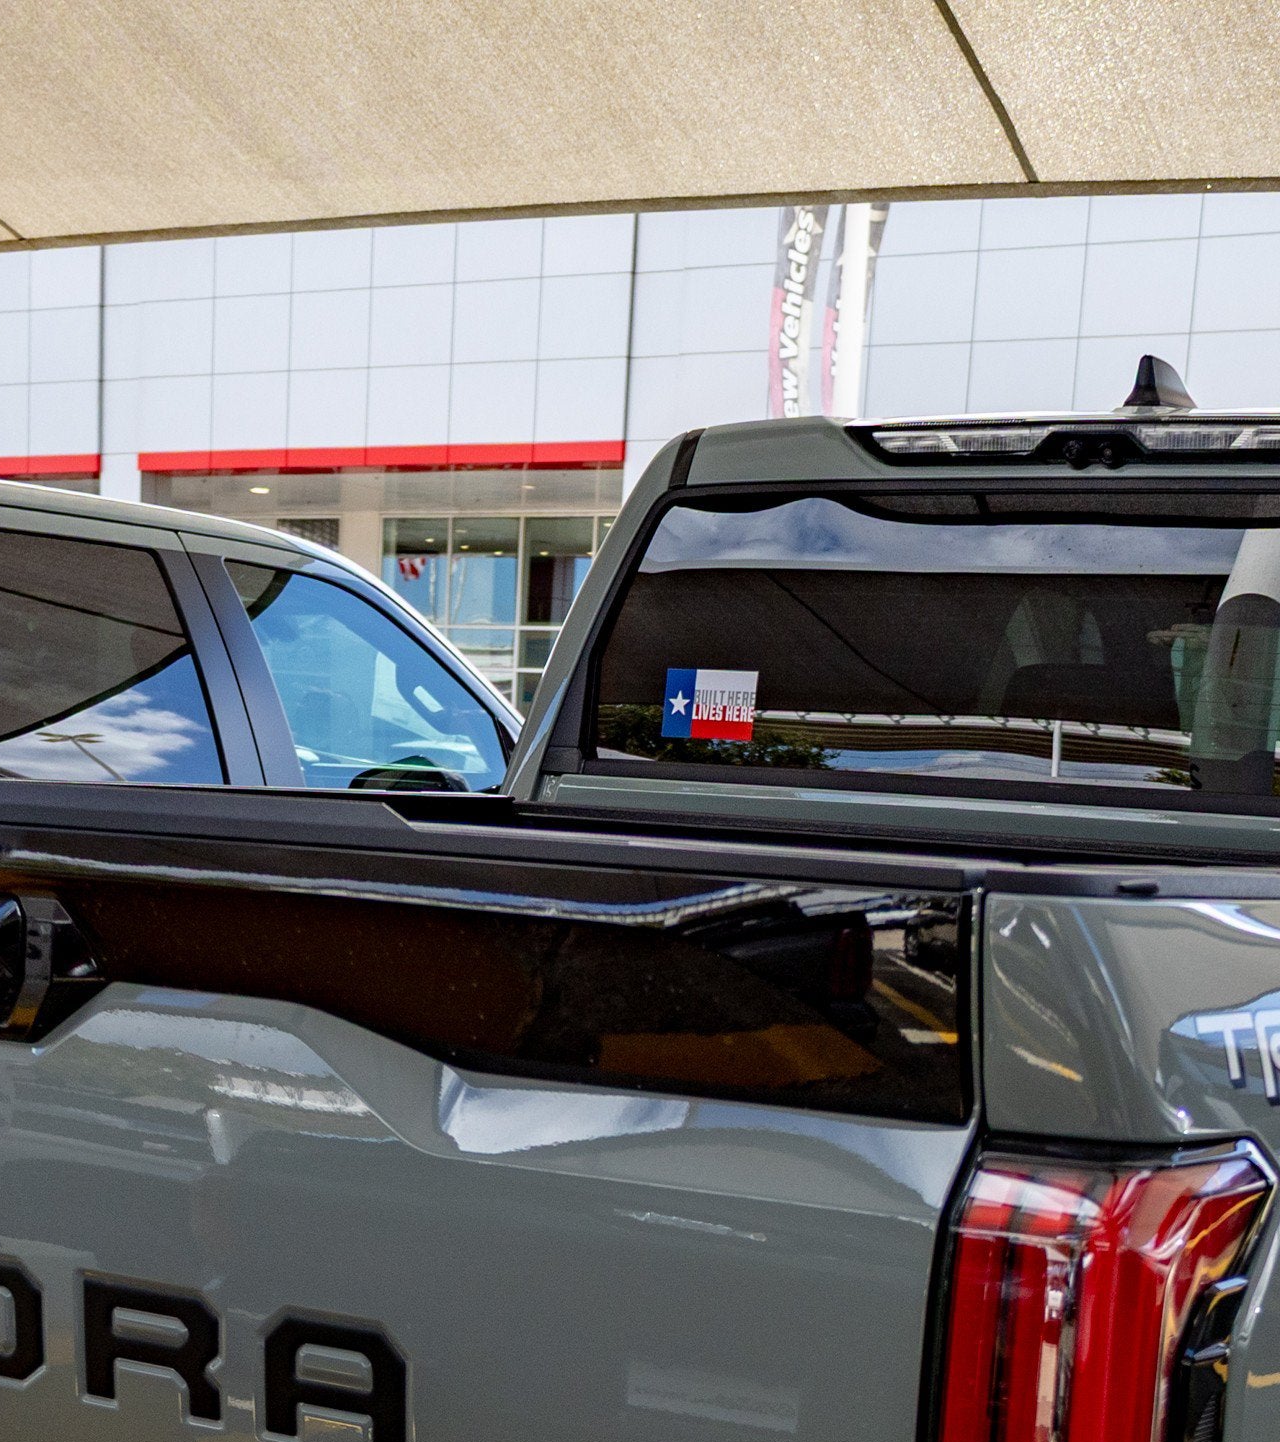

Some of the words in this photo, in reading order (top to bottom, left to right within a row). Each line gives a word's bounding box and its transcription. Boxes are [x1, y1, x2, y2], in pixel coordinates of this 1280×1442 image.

[779, 209, 815, 359] Vehicles
[694, 689, 725, 706] BUILT
[727, 691, 756, 707] HERE
[691, 704, 723, 721] LIVES
[724, 706, 754, 722] HERE
